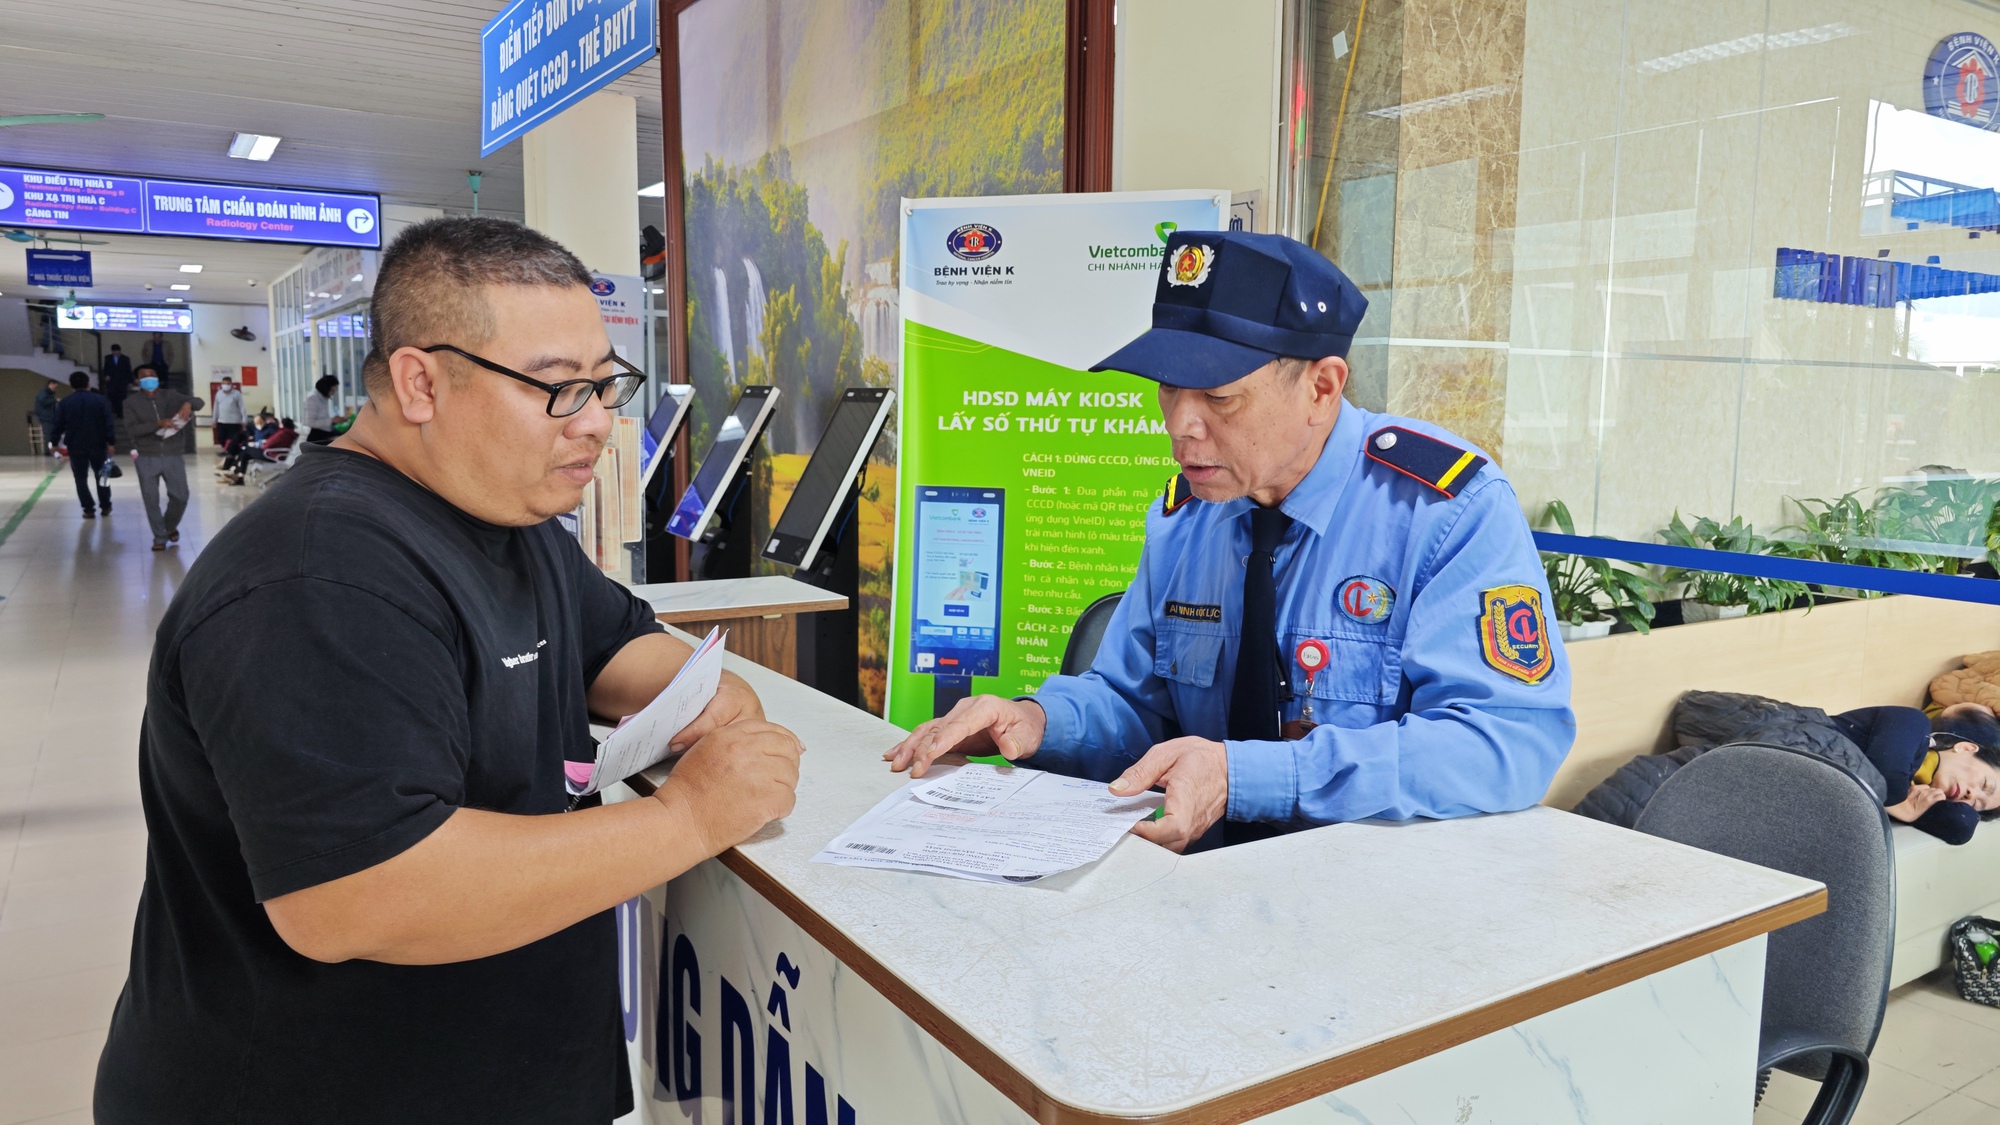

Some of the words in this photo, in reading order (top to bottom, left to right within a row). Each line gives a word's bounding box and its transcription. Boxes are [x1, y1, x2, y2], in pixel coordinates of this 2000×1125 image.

[500, 19, 522, 74] ĐIỂM
[523, 2, 544, 54] TIẾP
[491, 86, 514, 132] BẰNG
[516, 68, 538, 118] QUÉT
[541, 50, 568, 98] CCCD
[578, 14, 600, 74] THẺ
[604, 0, 637, 58] BHYT
[23, 174, 43, 184] KHU
[106, 181, 113, 189] B
[24, 192, 44, 201] KHU
[60, 194, 76, 204] TRỊ
[78, 195, 97, 205] NHÀ
[98, 197, 105, 205] C
[53, 210, 69, 219] TIN
[153, 195, 193, 212] TRUNG
[195, 196, 220, 215] TÂM
[223, 196, 254, 217] CHẨN
[256, 201, 287, 219] ĐOÁN
[290, 202, 316, 221] HÌNH
[319, 202, 342, 223] ẢNH
[206, 218, 257, 230] Radiology
[261, 222, 294, 231] Center
[1089, 244, 1166, 258] Vietcomba
[934, 265, 968, 278] BỆNH
[972, 264, 1002, 278] VIỆN
[1006, 266, 1014, 275] K
[1088, 263, 1105, 271] CHI
[1108, 261, 1146, 271] NHÁNH
[963, 391, 1018, 406] HDSD
[1026, 388, 1072, 407] MÁY
[1079, 392, 1144, 408] KIOSK
[938, 411, 976, 431] LẤY
[983, 412, 1009, 431] SỐ
[1016, 416, 1062, 432] THỨ
[1066, 418, 1098, 436] TỰ
[1104, 413, 1168, 435] KHÁM
[1023, 453, 1052, 462] CÁCH
[1064, 452, 1096, 464] DÙNG
[1098, 456, 1132, 466] CCCD,
[1134, 454, 1159, 466] ỨNG
[1162, 456, 1180, 468] DỤ
[1022, 468, 1056, 478] VNEID
[1032, 485, 1056, 494] Bước
[1077, 487, 1096, 496] Đưa
[1103, 486, 1126, 498] phần
[1133, 489, 1148, 497] mã
[1026, 499, 1054, 509] CCCD
[1056, 500, 1081, 511] (hoặc
[1083, 502, 1098, 510] mã
[1100, 502, 1116, 512] QR
[1136, 504, 1149, 512] CC
[1026, 514, 1043, 524] ứng
[1047, 514, 1069, 526] dụng
[1108, 517, 1126, 526] vào
[1026, 528, 1040, 536] trái
[1043, 529, 1063, 538] màn
[1065, 529, 1085, 539] hình
[1100, 532, 1120, 541] màu
[1025, 542, 1038, 551] khi
[1040, 543, 1060, 553] hiện
[1062, 544, 1079, 553] đèn
[1081, 545, 1106, 554] xanh.
[1030, 559, 1054, 569] Bước
[1057, 561, 1066, 569] 2:
[1069, 561, 1093, 572] Bệnh
[1095, 563, 1118, 572] nhân
[1024, 574, 1035, 582] tin
[1040, 575, 1050, 583] cá
[1056, 575, 1079, 584] nhân
[1084, 577, 1095, 586] và
[1100, 578, 1122, 588] chọn
[1024, 589, 1044, 597] theo
[1046, 590, 1062, 598] nhu
[1064, 590, 1082, 600] cầu.
[1028, 604, 1052, 614] Bước
[1055, 606, 1064, 615] 3:
[1017, 622, 1046, 632] CÁCH
[1049, 625, 1058, 633] 2:
[1016, 635, 1048, 647] NHÂN
[1026, 654, 1051, 664] Bước
[1020, 668, 1041, 678] màn
